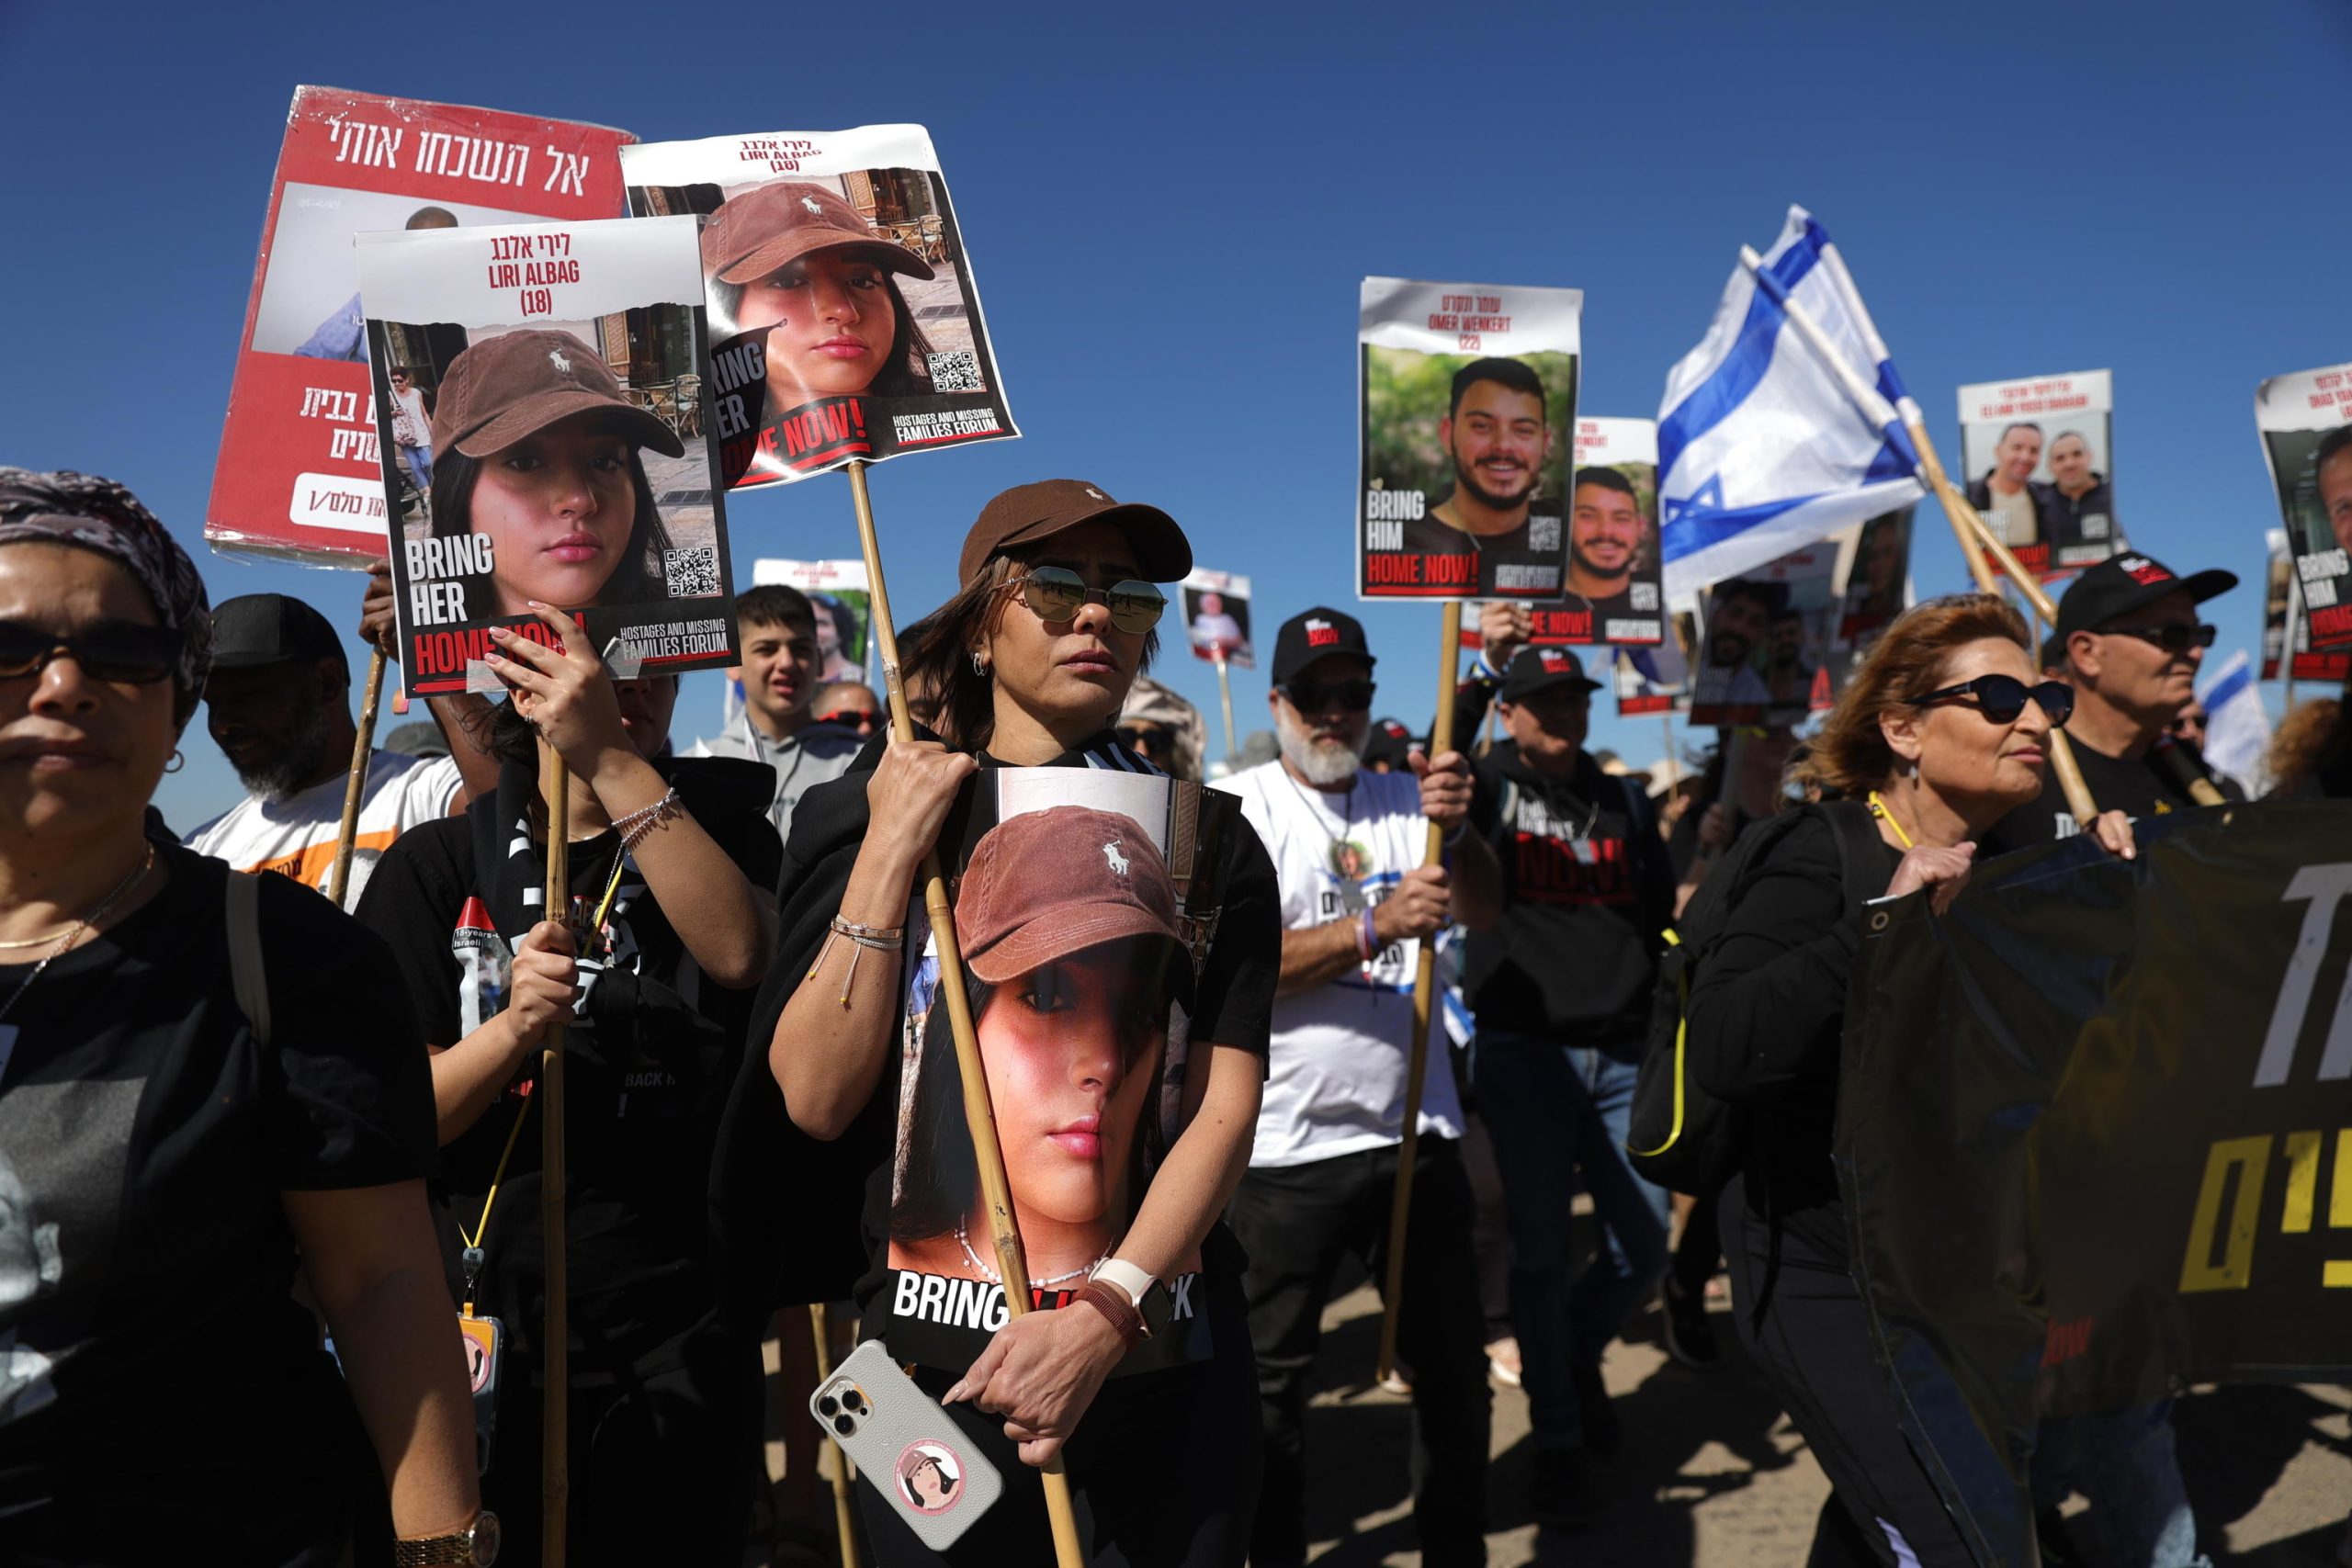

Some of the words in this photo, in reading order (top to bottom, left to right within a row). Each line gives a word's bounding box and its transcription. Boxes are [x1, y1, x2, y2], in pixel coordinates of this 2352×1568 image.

[326, 118, 404, 169] אותי
[740, 151, 769, 162] LIRI
[773, 148, 823, 160] ALBAG
[741, 140, 778, 152] אלבג
[780, 140, 812, 152] לירי
[415, 130, 530, 188] תשכחו
[544, 144, 591, 197] אל
[770, 160, 800, 173] (18)
[491, 234, 532, 262] אלבג
[537, 232, 571, 259] לירי
[488, 264, 522, 289] LIRI
[525, 258, 581, 288] ALBAG
[519, 288, 554, 317] (18)
[1428, 314, 1459, 331] OMER
[1463, 316, 1511, 333] WENKERT
[710, 341, 766, 394] RING
[300, 387, 358, 423] בבית
[715, 394, 751, 440] ER
[892, 413, 937, 427] HOSTAGES
[937, 411, 956, 423] AND
[956, 407, 994, 421] MISSING
[782, 397, 867, 457] NOW!
[896, 423, 954, 444] FAMILIES
[954, 417, 1001, 435] FORUM
[1366, 490, 1425, 521] BRING
[1366, 521, 1404, 550] HIM
[404, 532, 494, 581] BRING
[1367, 553, 1420, 583] HOME
[1425, 552, 1480, 583] NOW!
[411, 581, 469, 626] HER
[619, 623, 665, 641] HOSTAGES
[666, 620, 685, 636] AND
[685, 617, 727, 634] MISSING
[622, 637, 681, 660] FAMILIES
[682, 631, 729, 655] FORUM
[454, 939, 481, 948] Israeli
[625, 1071, 662, 1088] BACK
[893, 1269, 1010, 1333] BRING
